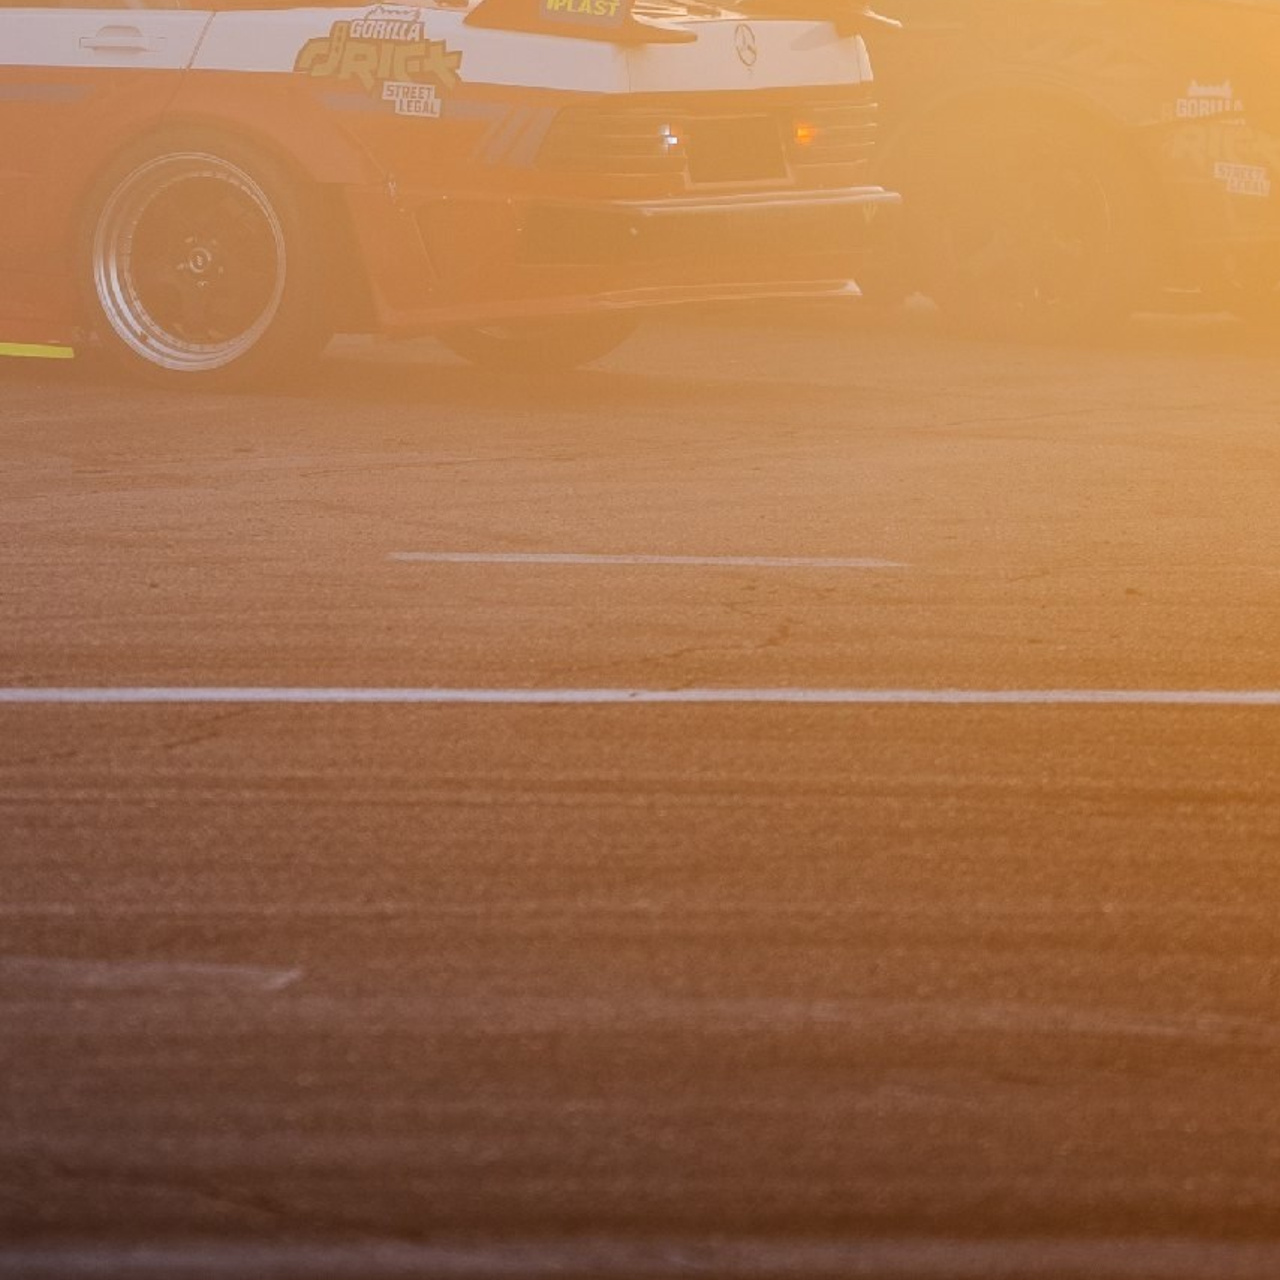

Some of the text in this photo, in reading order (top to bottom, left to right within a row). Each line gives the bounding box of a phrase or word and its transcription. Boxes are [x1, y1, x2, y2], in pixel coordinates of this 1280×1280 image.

[350, 21, 421, 42] GORILLA
[385, 84, 433, 100] STREET
[399, 99, 438, 115] LEGAL
